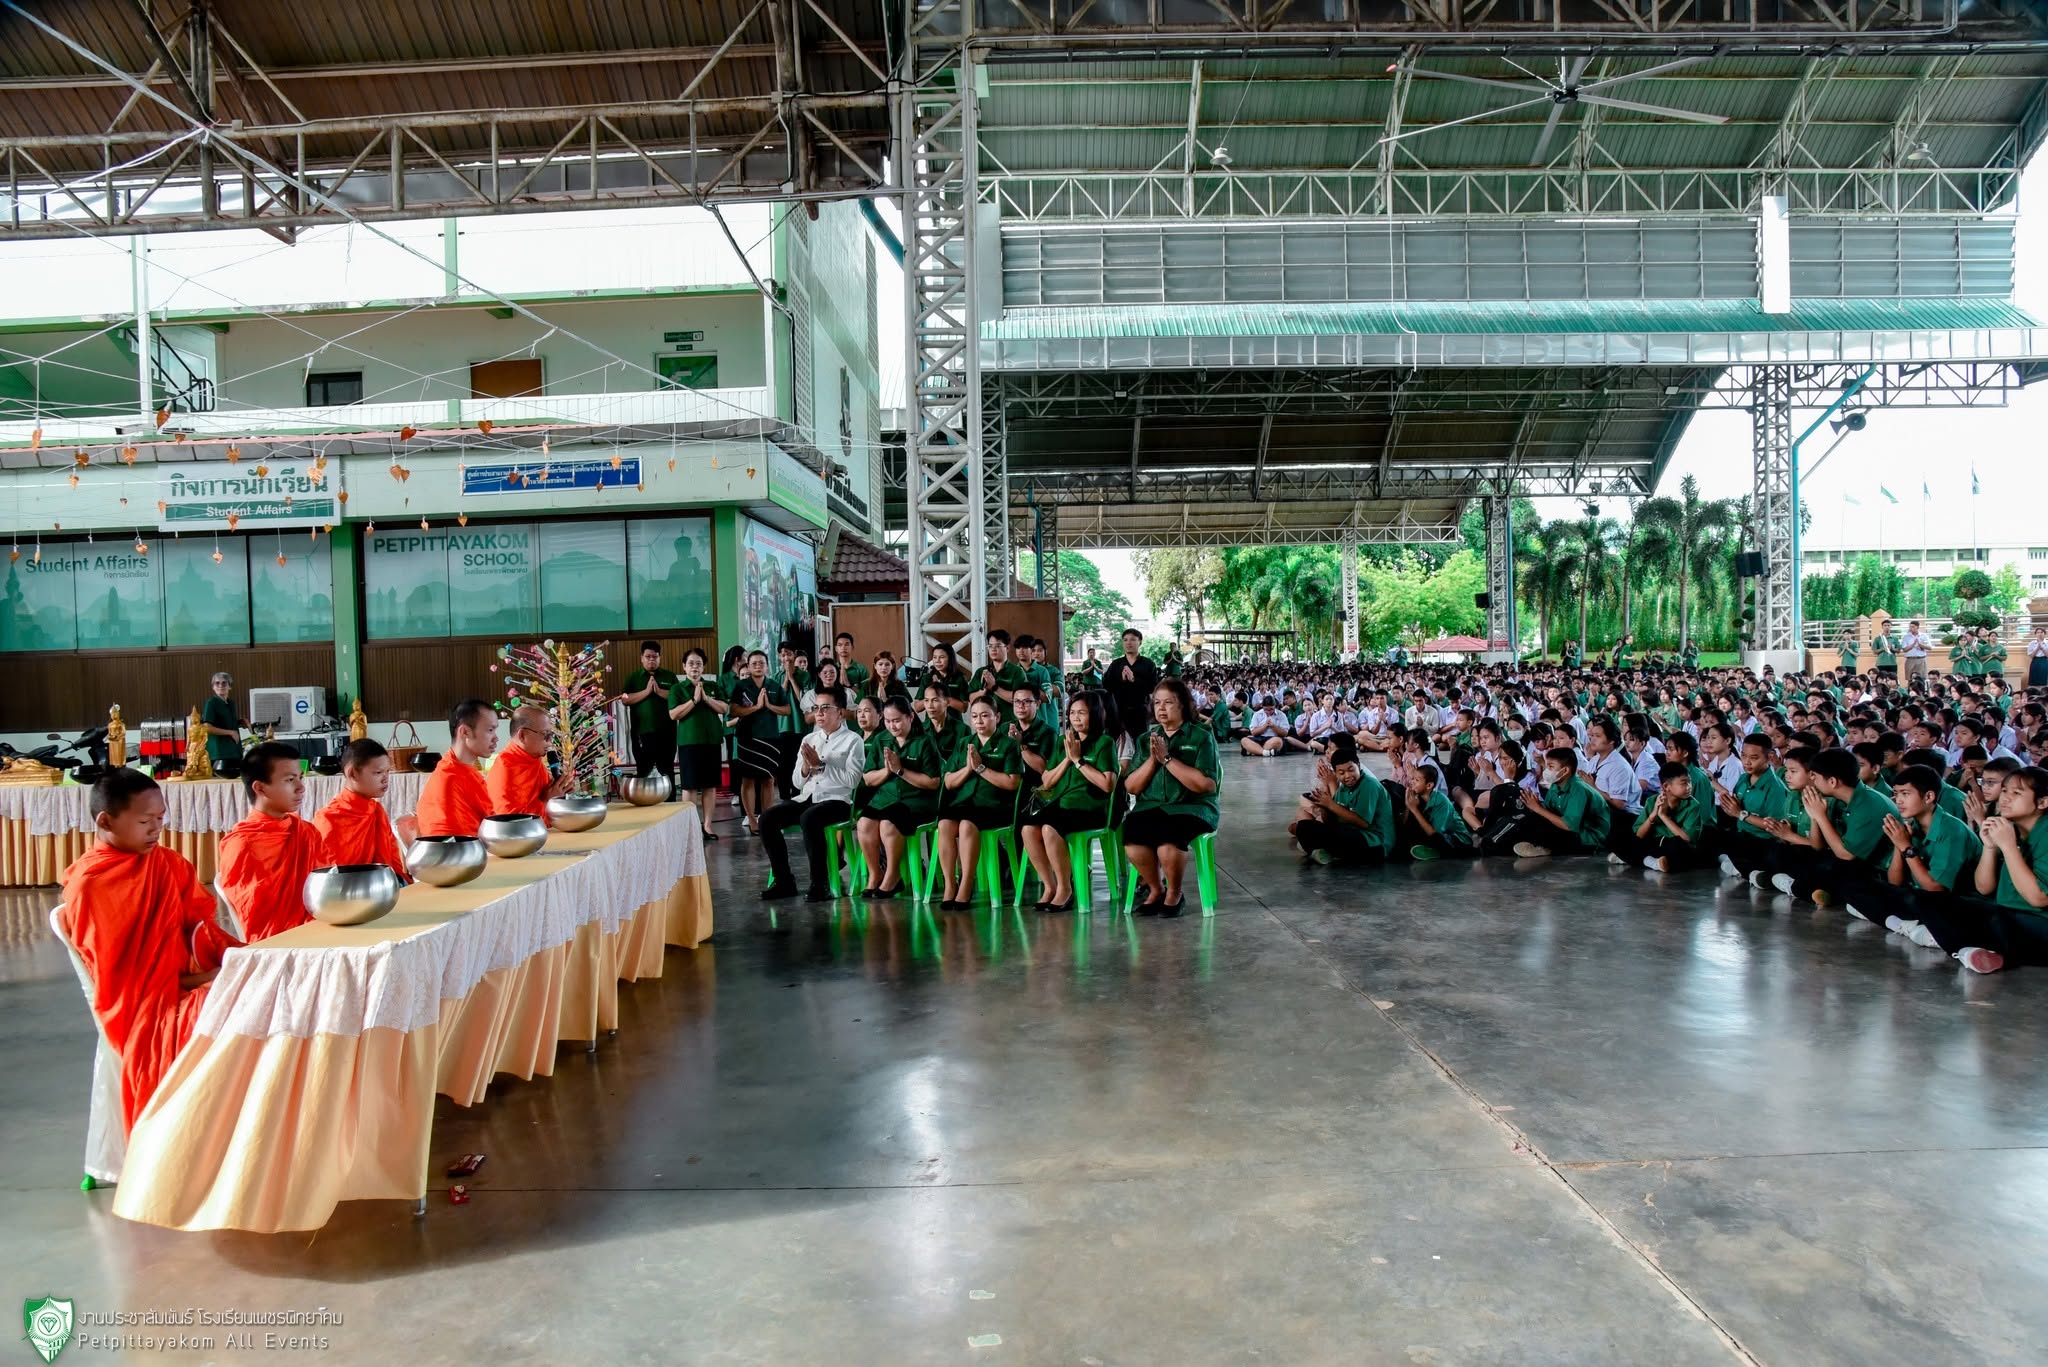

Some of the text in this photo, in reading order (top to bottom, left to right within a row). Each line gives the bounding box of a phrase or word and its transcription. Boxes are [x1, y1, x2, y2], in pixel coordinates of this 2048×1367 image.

[170, 468, 328, 497] กิจการนักเรียน
[206, 504, 292, 517] Student Affairs
[373, 533, 529, 553] PETPITTAYAKOM
[25, 555, 149, 574] Student Affairs
[463, 553, 529, 566] SCHOOL
